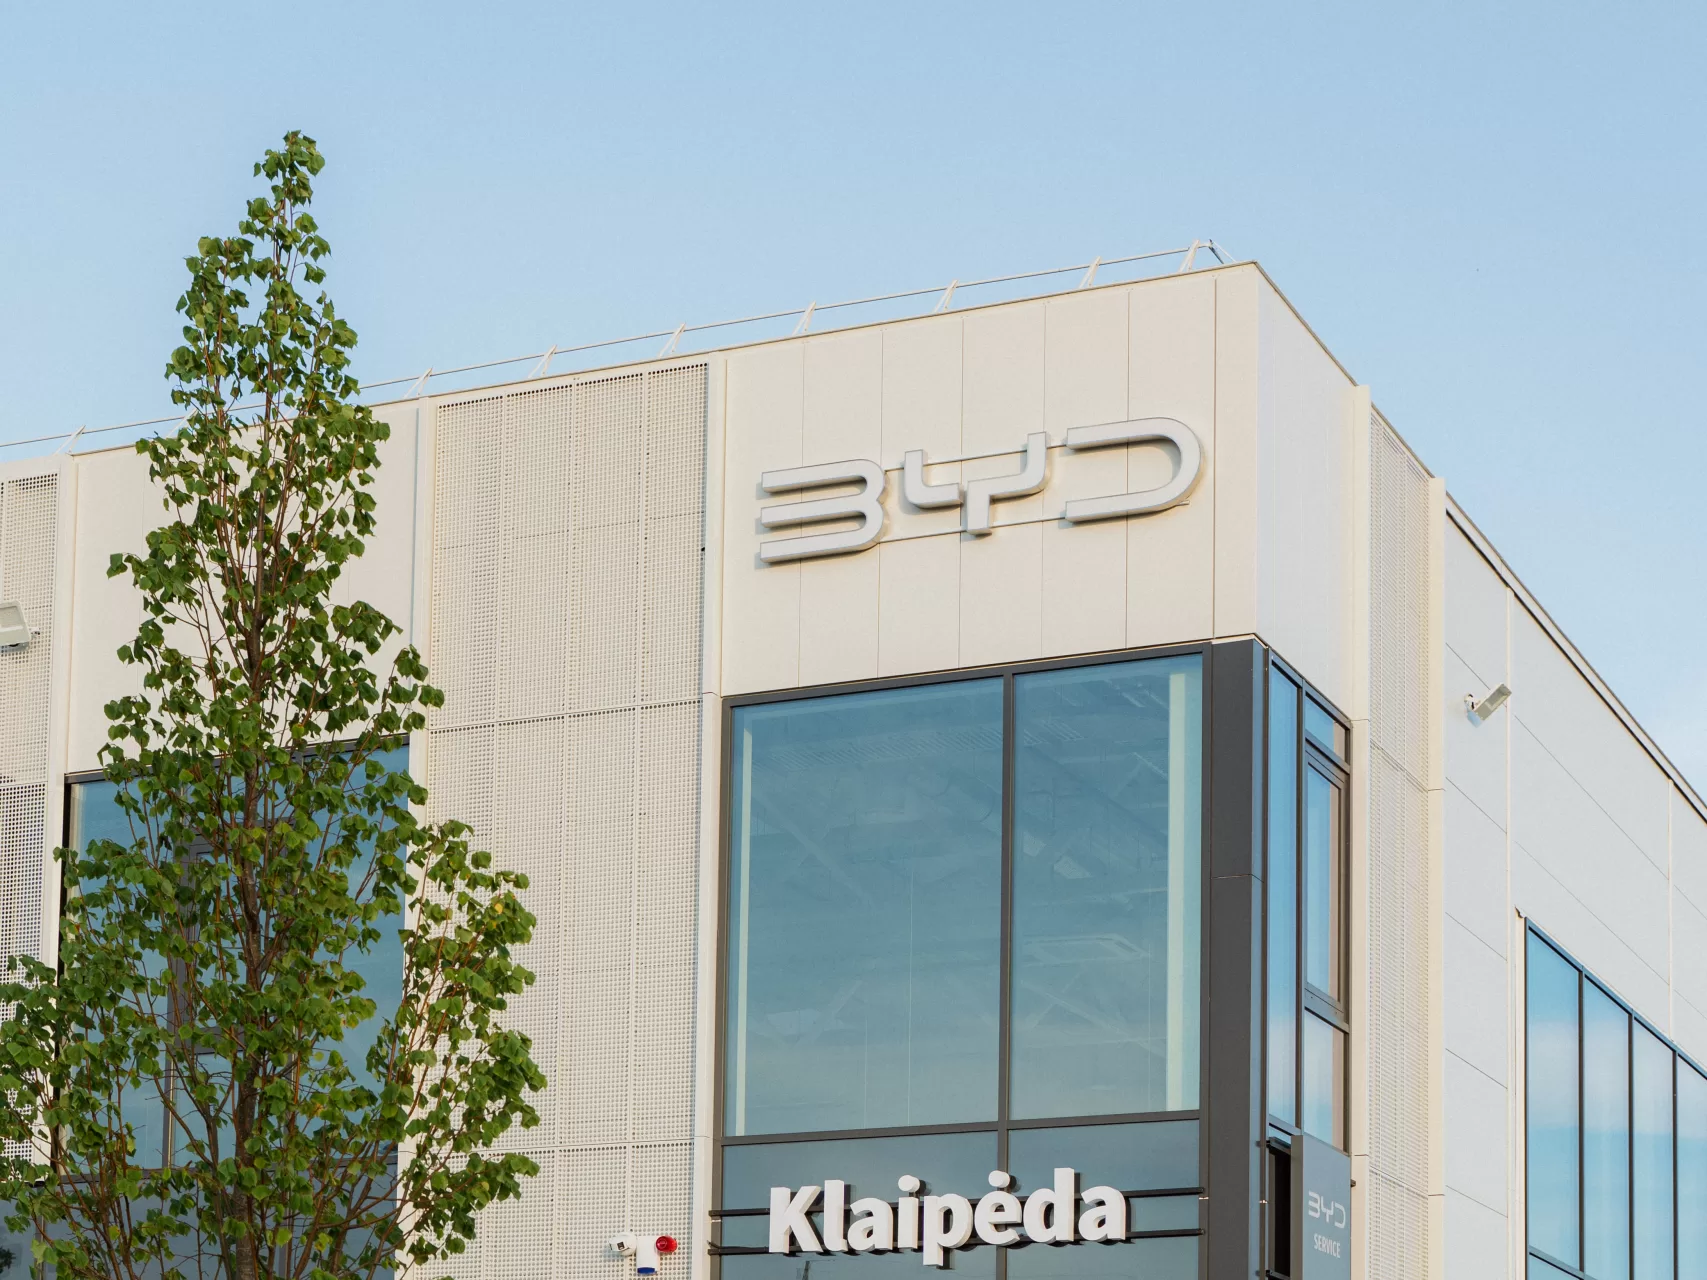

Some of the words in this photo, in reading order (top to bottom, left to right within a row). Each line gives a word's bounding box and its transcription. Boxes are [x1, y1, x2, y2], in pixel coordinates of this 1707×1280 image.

[760, 417, 1201, 563] BYD
[769, 1167, 1126, 1267] Klaipėda
[1308, 1190, 1346, 1229] BYD
[1313, 1233, 1341, 1258] SERVICE
